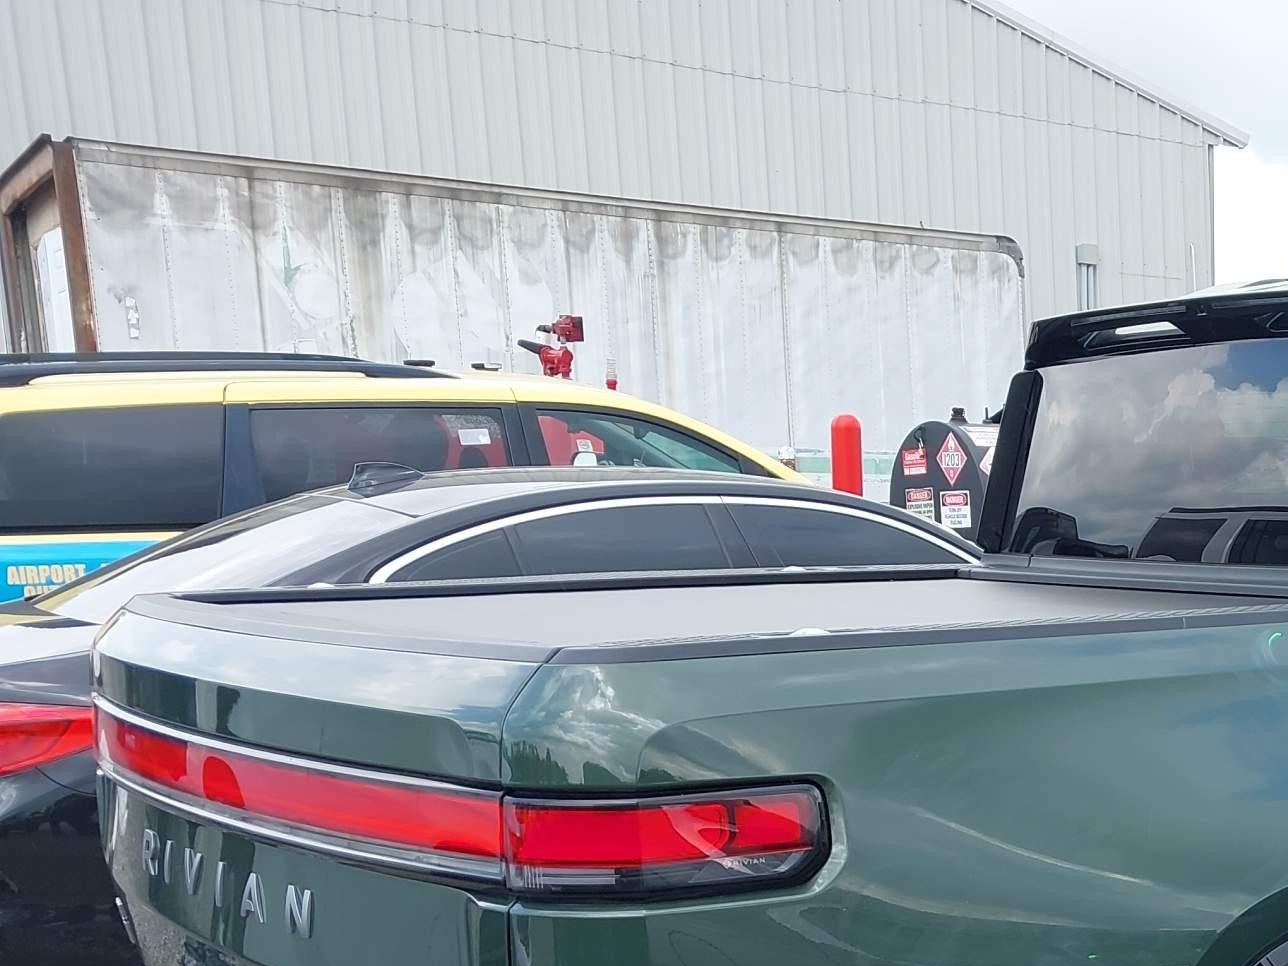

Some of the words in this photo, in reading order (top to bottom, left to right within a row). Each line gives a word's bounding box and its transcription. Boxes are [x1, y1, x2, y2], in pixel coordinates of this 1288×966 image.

[944, 454, 960, 467] 1203
[7, 564, 86, 585] AIRPORT
[143, 829, 313, 939] RIVIAN
